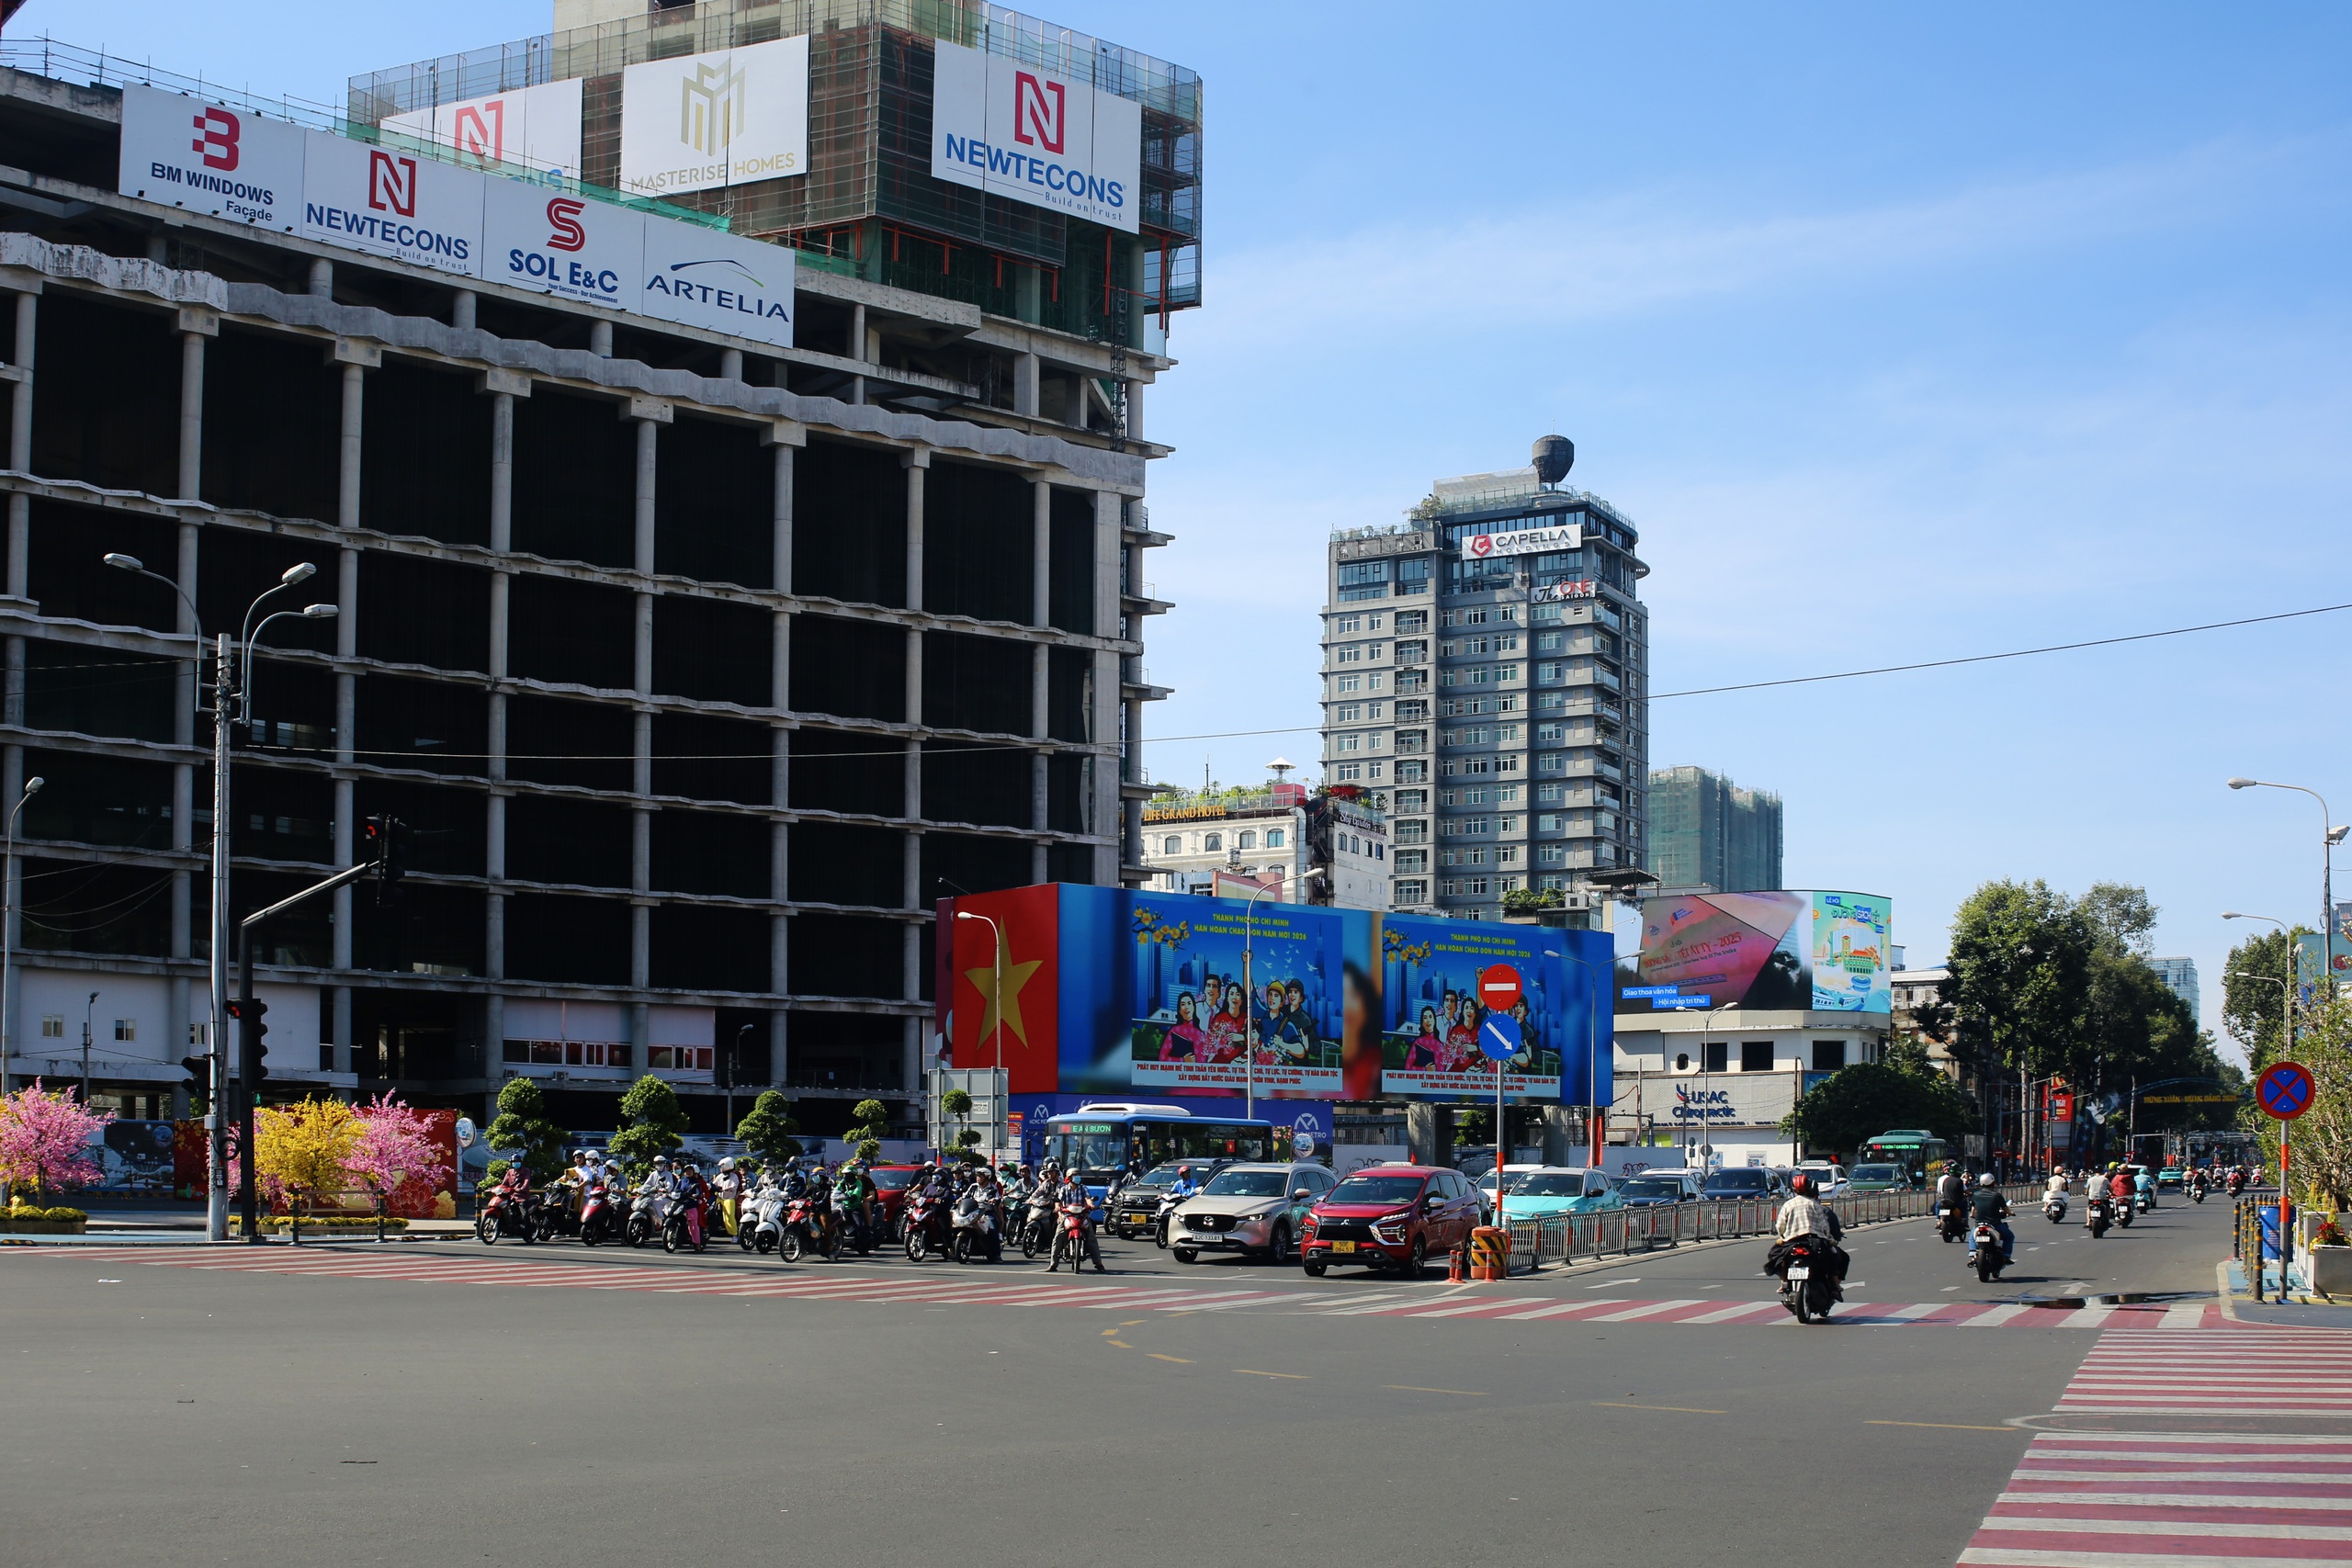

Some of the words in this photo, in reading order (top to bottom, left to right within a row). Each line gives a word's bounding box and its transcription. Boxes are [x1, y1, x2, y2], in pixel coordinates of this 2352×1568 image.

[631, 164, 727, 192] MASTERISE
[733, 152, 796, 176] HOMES
[946, 133, 1124, 208] NEWTECONS
[152, 162, 182, 184] BM
[187, 170, 274, 206] WINDOWS
[227, 200, 272, 222] Façade
[1046, 191, 1072, 208] Build
[1077, 203, 1089, 212] on
[1092, 205, 1123, 222] trust
[307, 203, 469, 259] NEWTECONS
[396, 247, 421, 264] Build
[425, 254, 436, 265] on
[440, 254, 468, 271] trust
[509, 249, 564, 285] SOL
[569, 262, 618, 293] E&C
[646, 275, 789, 322] ARTELIA
[1496, 529, 1569, 547] CAPELLA
[1496, 541, 1572, 554] HOLDINGS
[1560, 579, 1590, 594] ONE
[1144, 809, 1160, 821] LIFE
[1162, 807, 1195, 819] GRAND
[1197, 805, 1227, 817] HOTEL
[1718, 931, 1742, 947] 2025
[1669, 998, 1685, 1006] nhập
